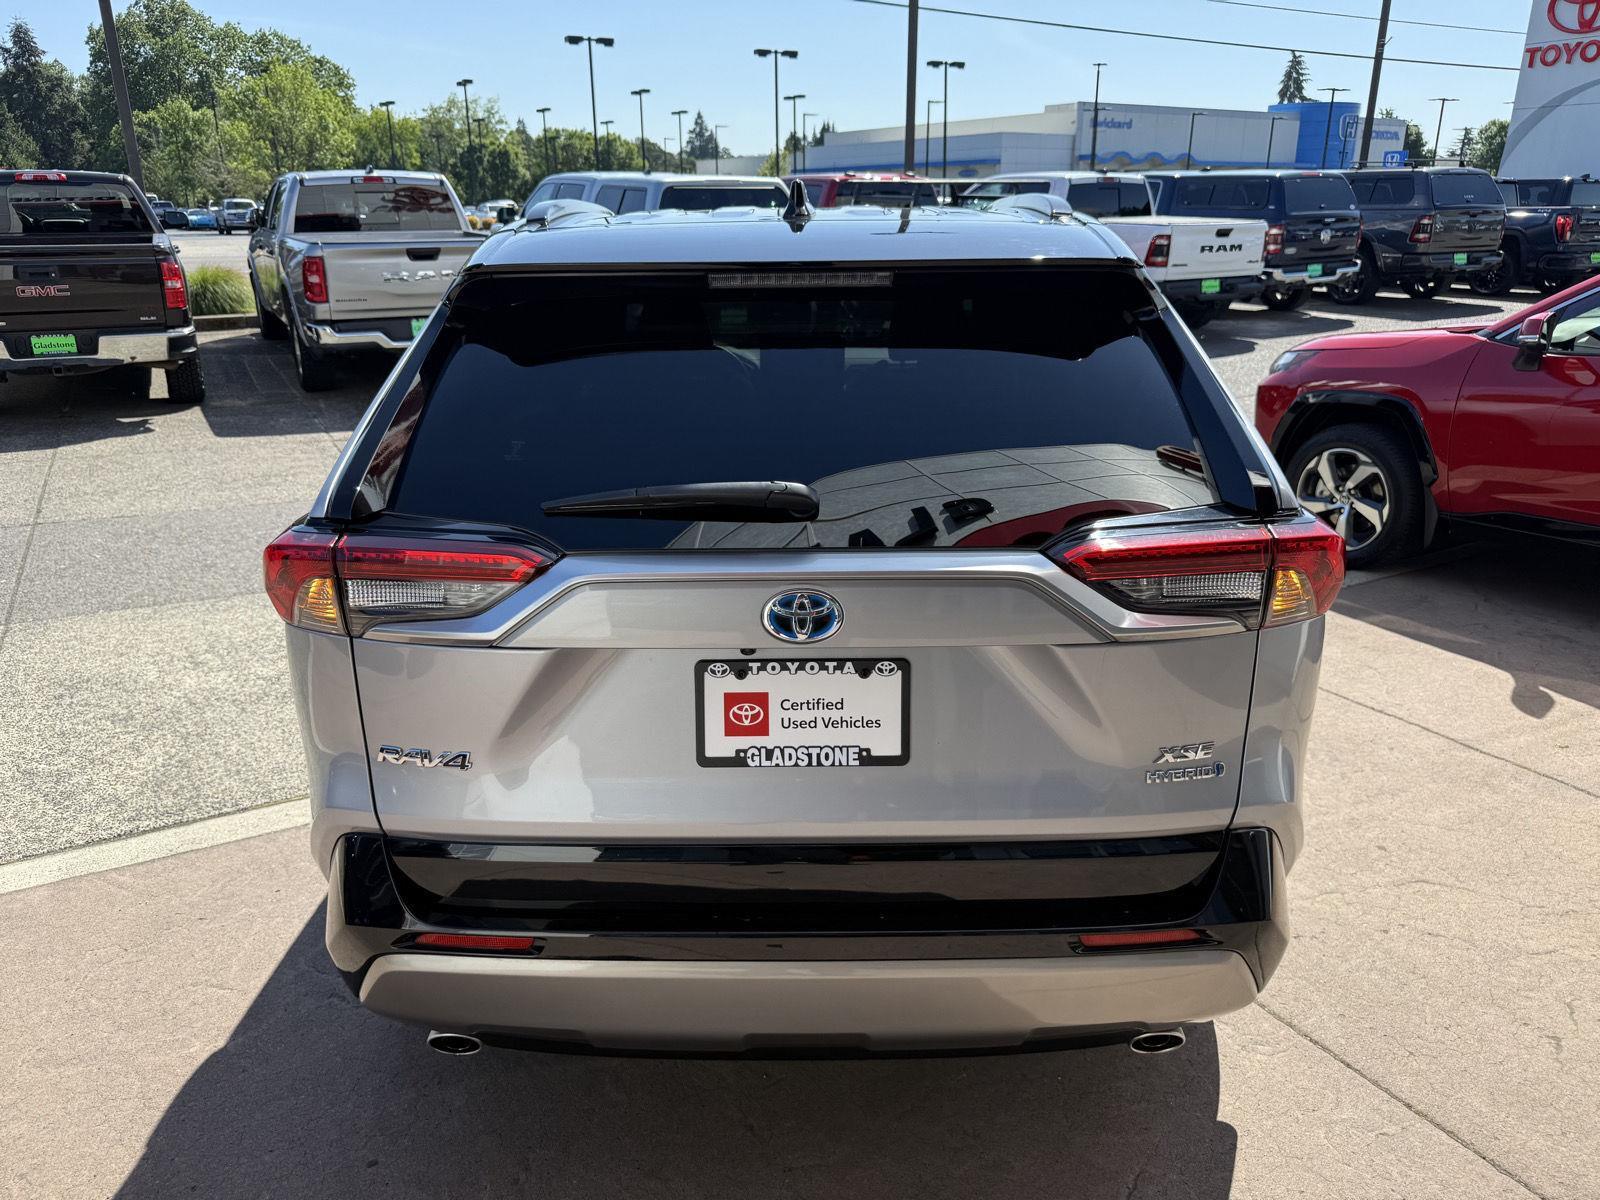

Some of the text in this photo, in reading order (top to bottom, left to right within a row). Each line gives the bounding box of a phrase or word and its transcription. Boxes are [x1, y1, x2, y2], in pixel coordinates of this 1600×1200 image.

[1200, 244, 1242, 253] RAM
[15, 284, 71, 297] GMC
[33, 341, 76, 350] Gladstone
[748, 660, 857, 676] TOYOTA
[780, 698, 844, 711] Certified
[781, 716, 882, 729] Used Vehicles
[377, 745, 473, 771] RAV4
[746, 746, 861, 767] GLADSTONE
[1152, 741, 1216, 764] XSE
[1145, 766, 1214, 784] HYBRID
